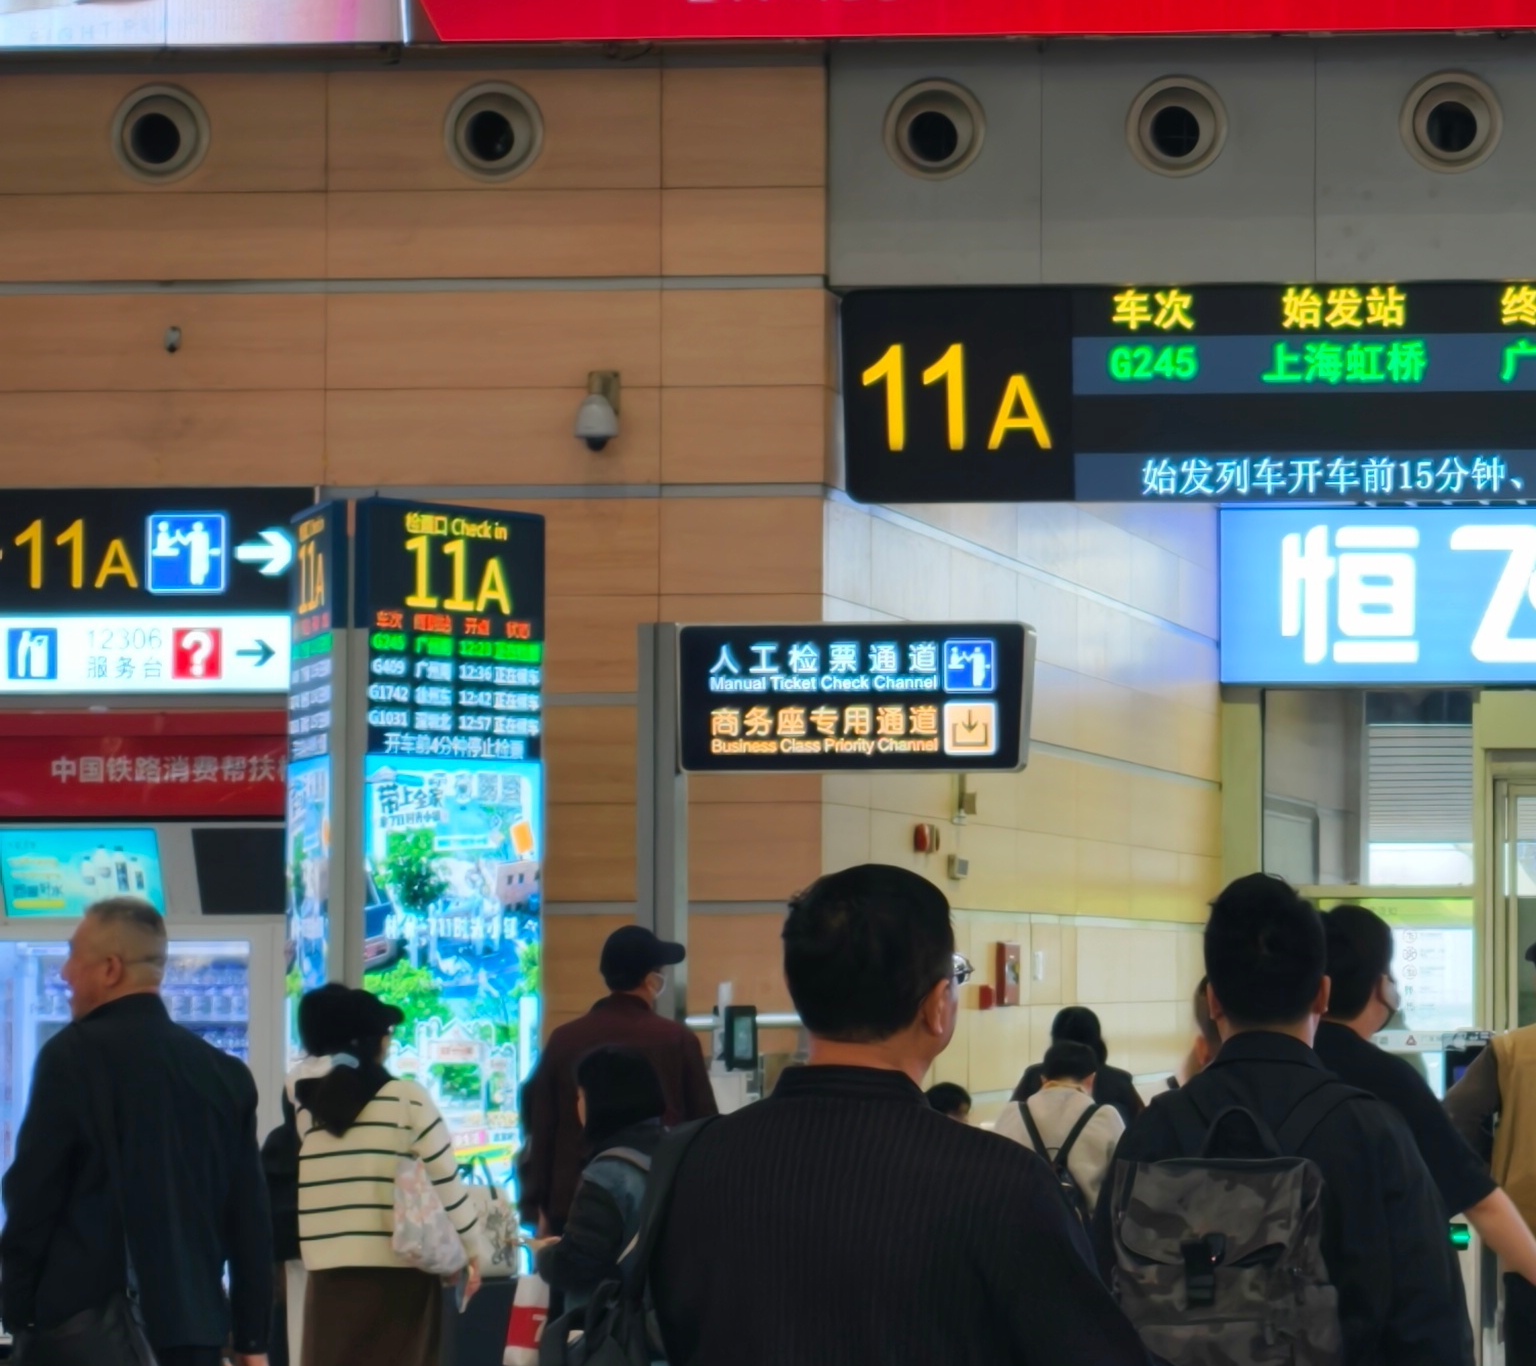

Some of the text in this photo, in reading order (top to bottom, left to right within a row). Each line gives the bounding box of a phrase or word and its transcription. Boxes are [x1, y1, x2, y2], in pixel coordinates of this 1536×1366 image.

[1113, 289, 1195, 330] 车次
[1282, 287, 1406, 329] 始发站
[1110, 346, 1198, 381] G245
[1262, 341, 1428, 383] 上海虹桥
[861, 343, 1053, 452] 11A
[450, 517, 491, 539] Check
[494, 521, 508, 540] in
[14, 519, 139, 589] 11A
[405, 535, 511, 615] 11A
[87, 628, 163, 649] 12306
[86, 656, 163, 680] 服务台
[708, 641, 938, 675] 人工检票通道
[459, 663, 492, 682] 12:36
[709, 676, 938, 692] Manual Ticket Check Channel
[369, 683, 409, 703] G1742
[459, 689, 492, 707] 12:42
[369, 709, 409, 728] G1031
[459, 714, 492, 731] 12:57
[710, 706, 939, 736] 商务座专用通道
[711, 738, 939, 758] Business Class Priority Channel
